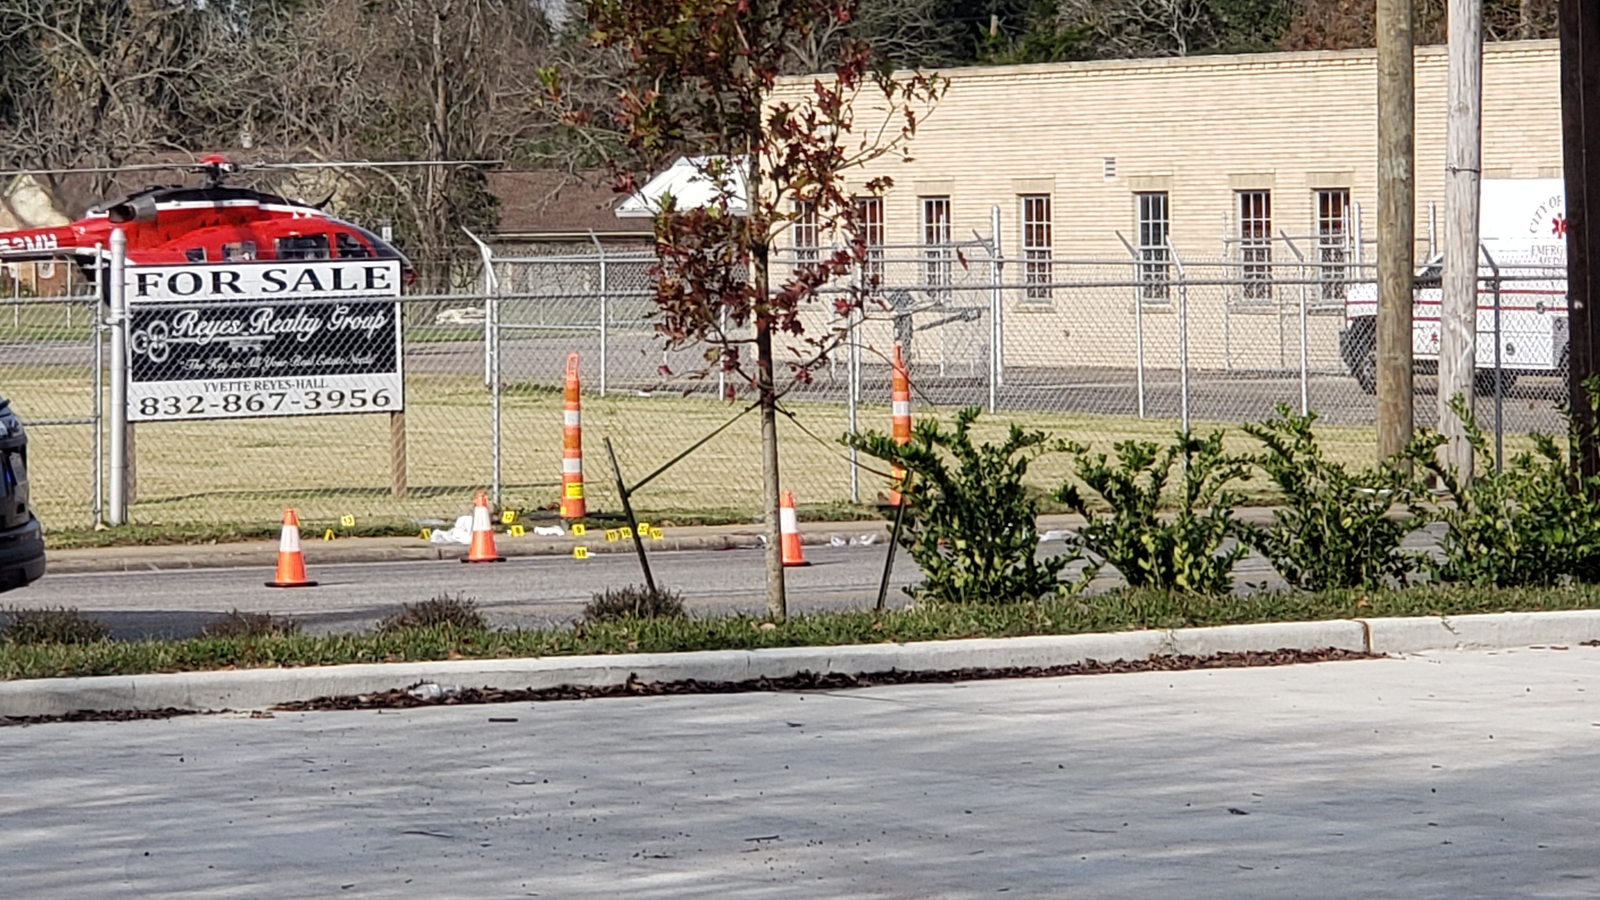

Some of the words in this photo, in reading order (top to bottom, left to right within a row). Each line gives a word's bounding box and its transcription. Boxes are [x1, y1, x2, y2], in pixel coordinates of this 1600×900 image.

[1529, 201, 1547, 233] CITY
[1549, 195, 1562, 209] OF
[135, 270, 246, 297] FOR
[261, 265, 392, 293] SALE
[172, 309, 243, 345] Reyes
[249, 307, 323, 342] Realty
[326, 304, 388, 339] Group
[261, 355, 288, 371] Your
[289, 353, 316, 367] Real
[316, 353, 348, 366] Estate
[203, 381, 251, 393] YVETTE
[254, 378, 329, 391] REYES-HALL
[139, 388, 391, 416] 832-867-3956
